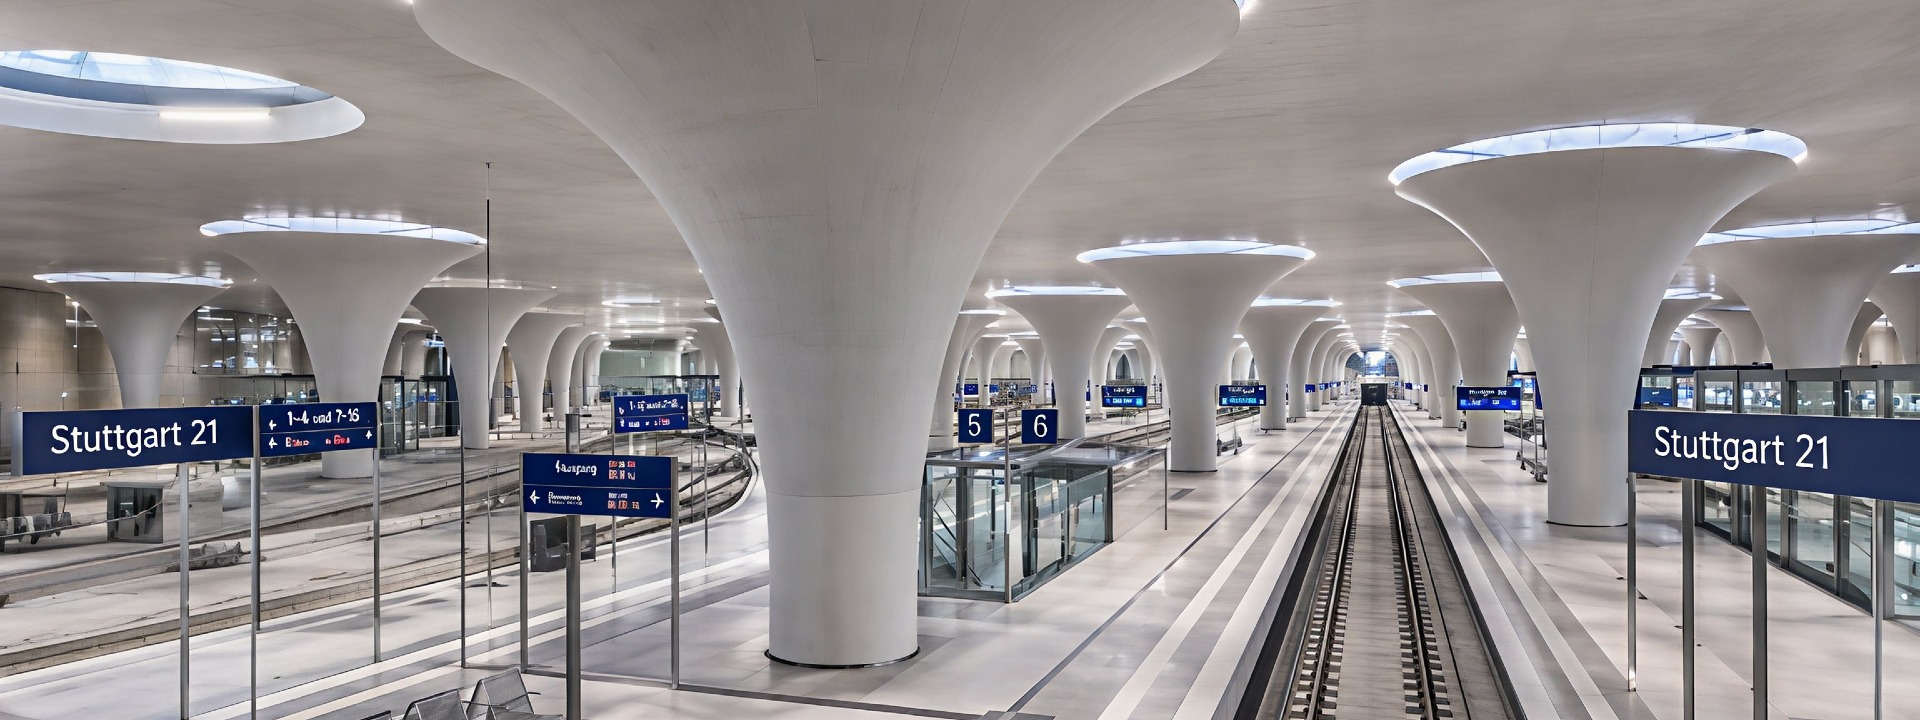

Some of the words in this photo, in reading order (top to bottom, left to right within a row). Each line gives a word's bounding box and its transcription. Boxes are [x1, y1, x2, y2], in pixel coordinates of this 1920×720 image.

[50, 422, 182, 458] Stuttgart
[190, 418, 217, 446] 21
[968, 413, 981, 437] 5
[1033, 413, 1048, 438] 6
[1654, 425, 1785, 471] Stuttgart
[1795, 433, 1829, 470] 21
